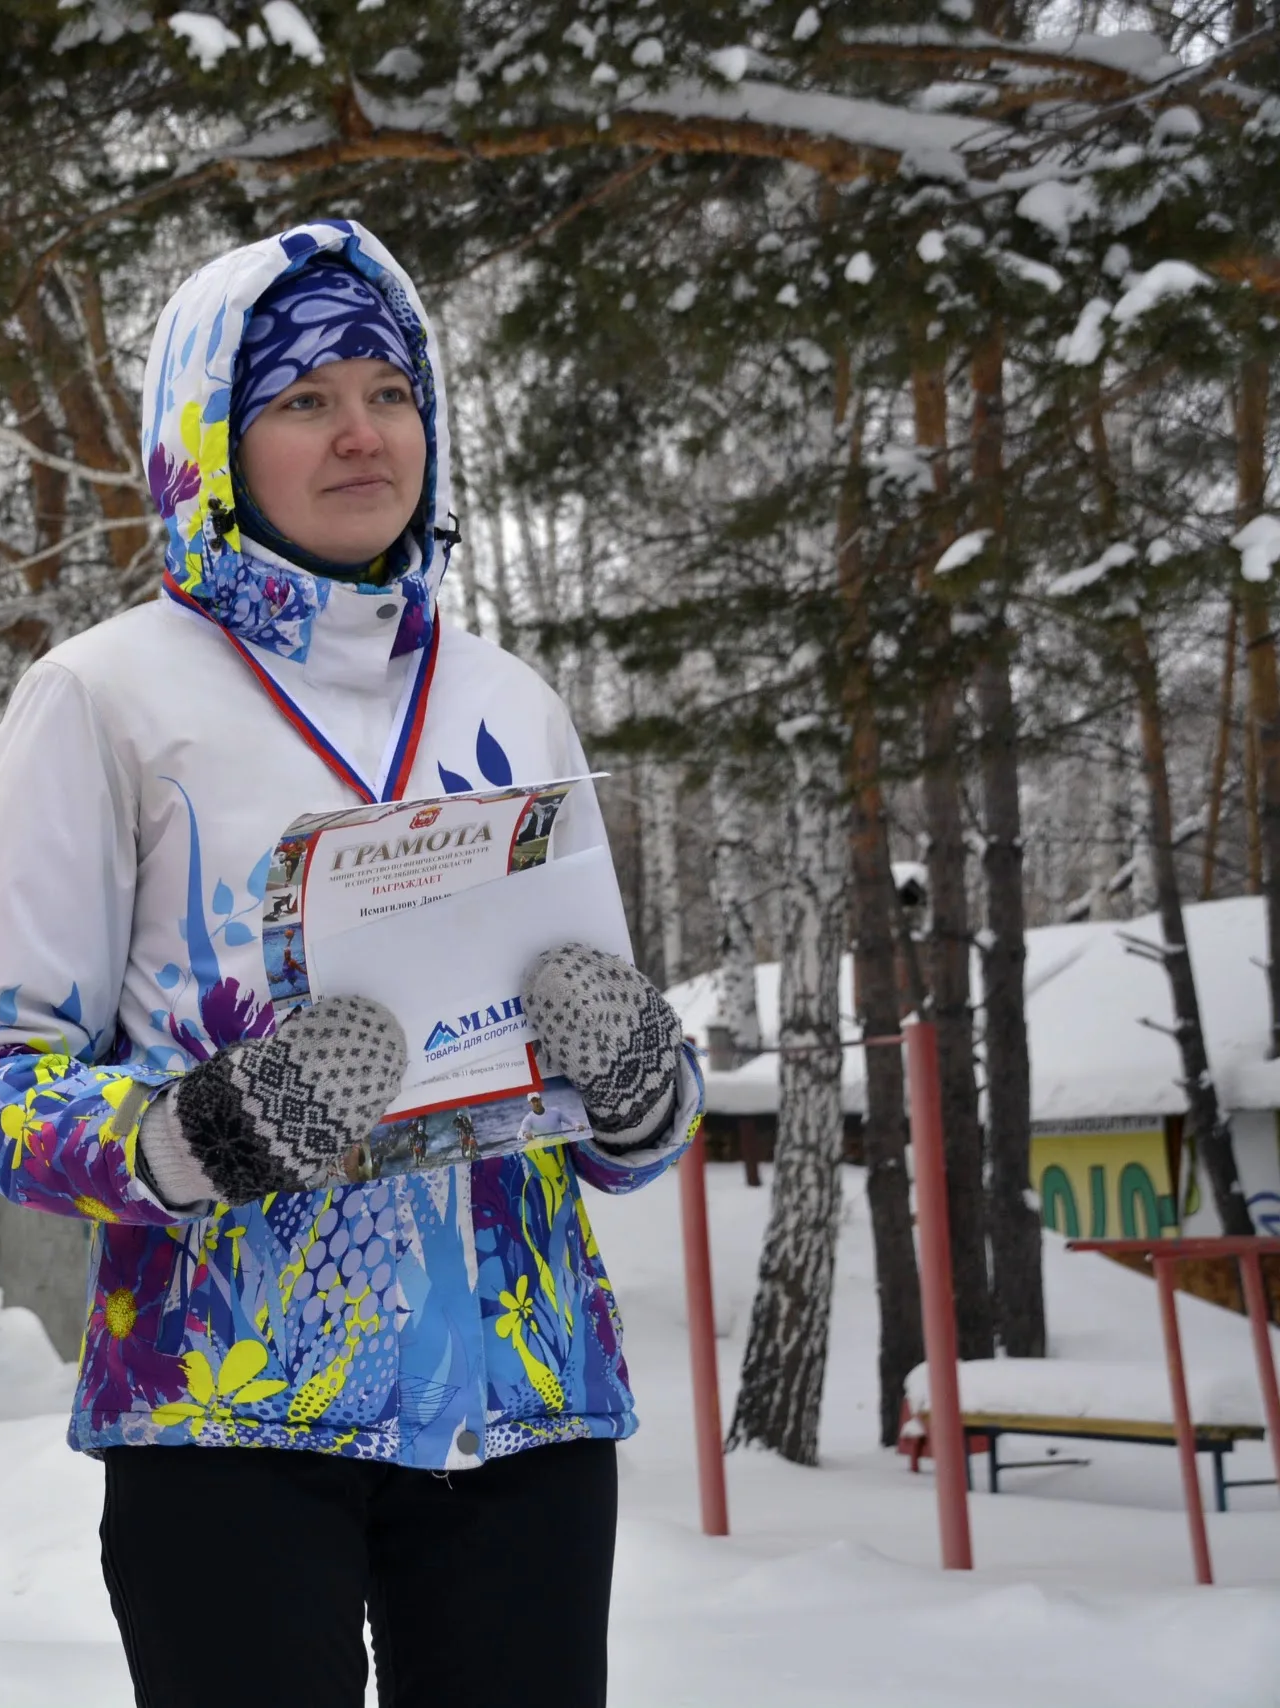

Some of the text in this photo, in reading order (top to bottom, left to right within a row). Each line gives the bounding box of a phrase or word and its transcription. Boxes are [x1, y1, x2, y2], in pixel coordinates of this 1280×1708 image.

[329, 820, 492, 871] ГРАМОТА
[329, 846, 489, 882] МИНИСТЕРСТВО ПО ФИЗИЧЕСКОЙ КУЛЬТУРЕ
[344, 858, 472, 888] И СПОРТУ ЧЕЛЯБИНСКОЙ ОБЛАСТИ
[372, 874, 442, 895] НАГРАЖДАЕТ
[360, 899, 418, 917] Исмагилову
[425, 1019, 528, 1063] ТОВАРЫ ДЛЯ СПОРТА И
[495, 1061, 510, 1071] 2019
